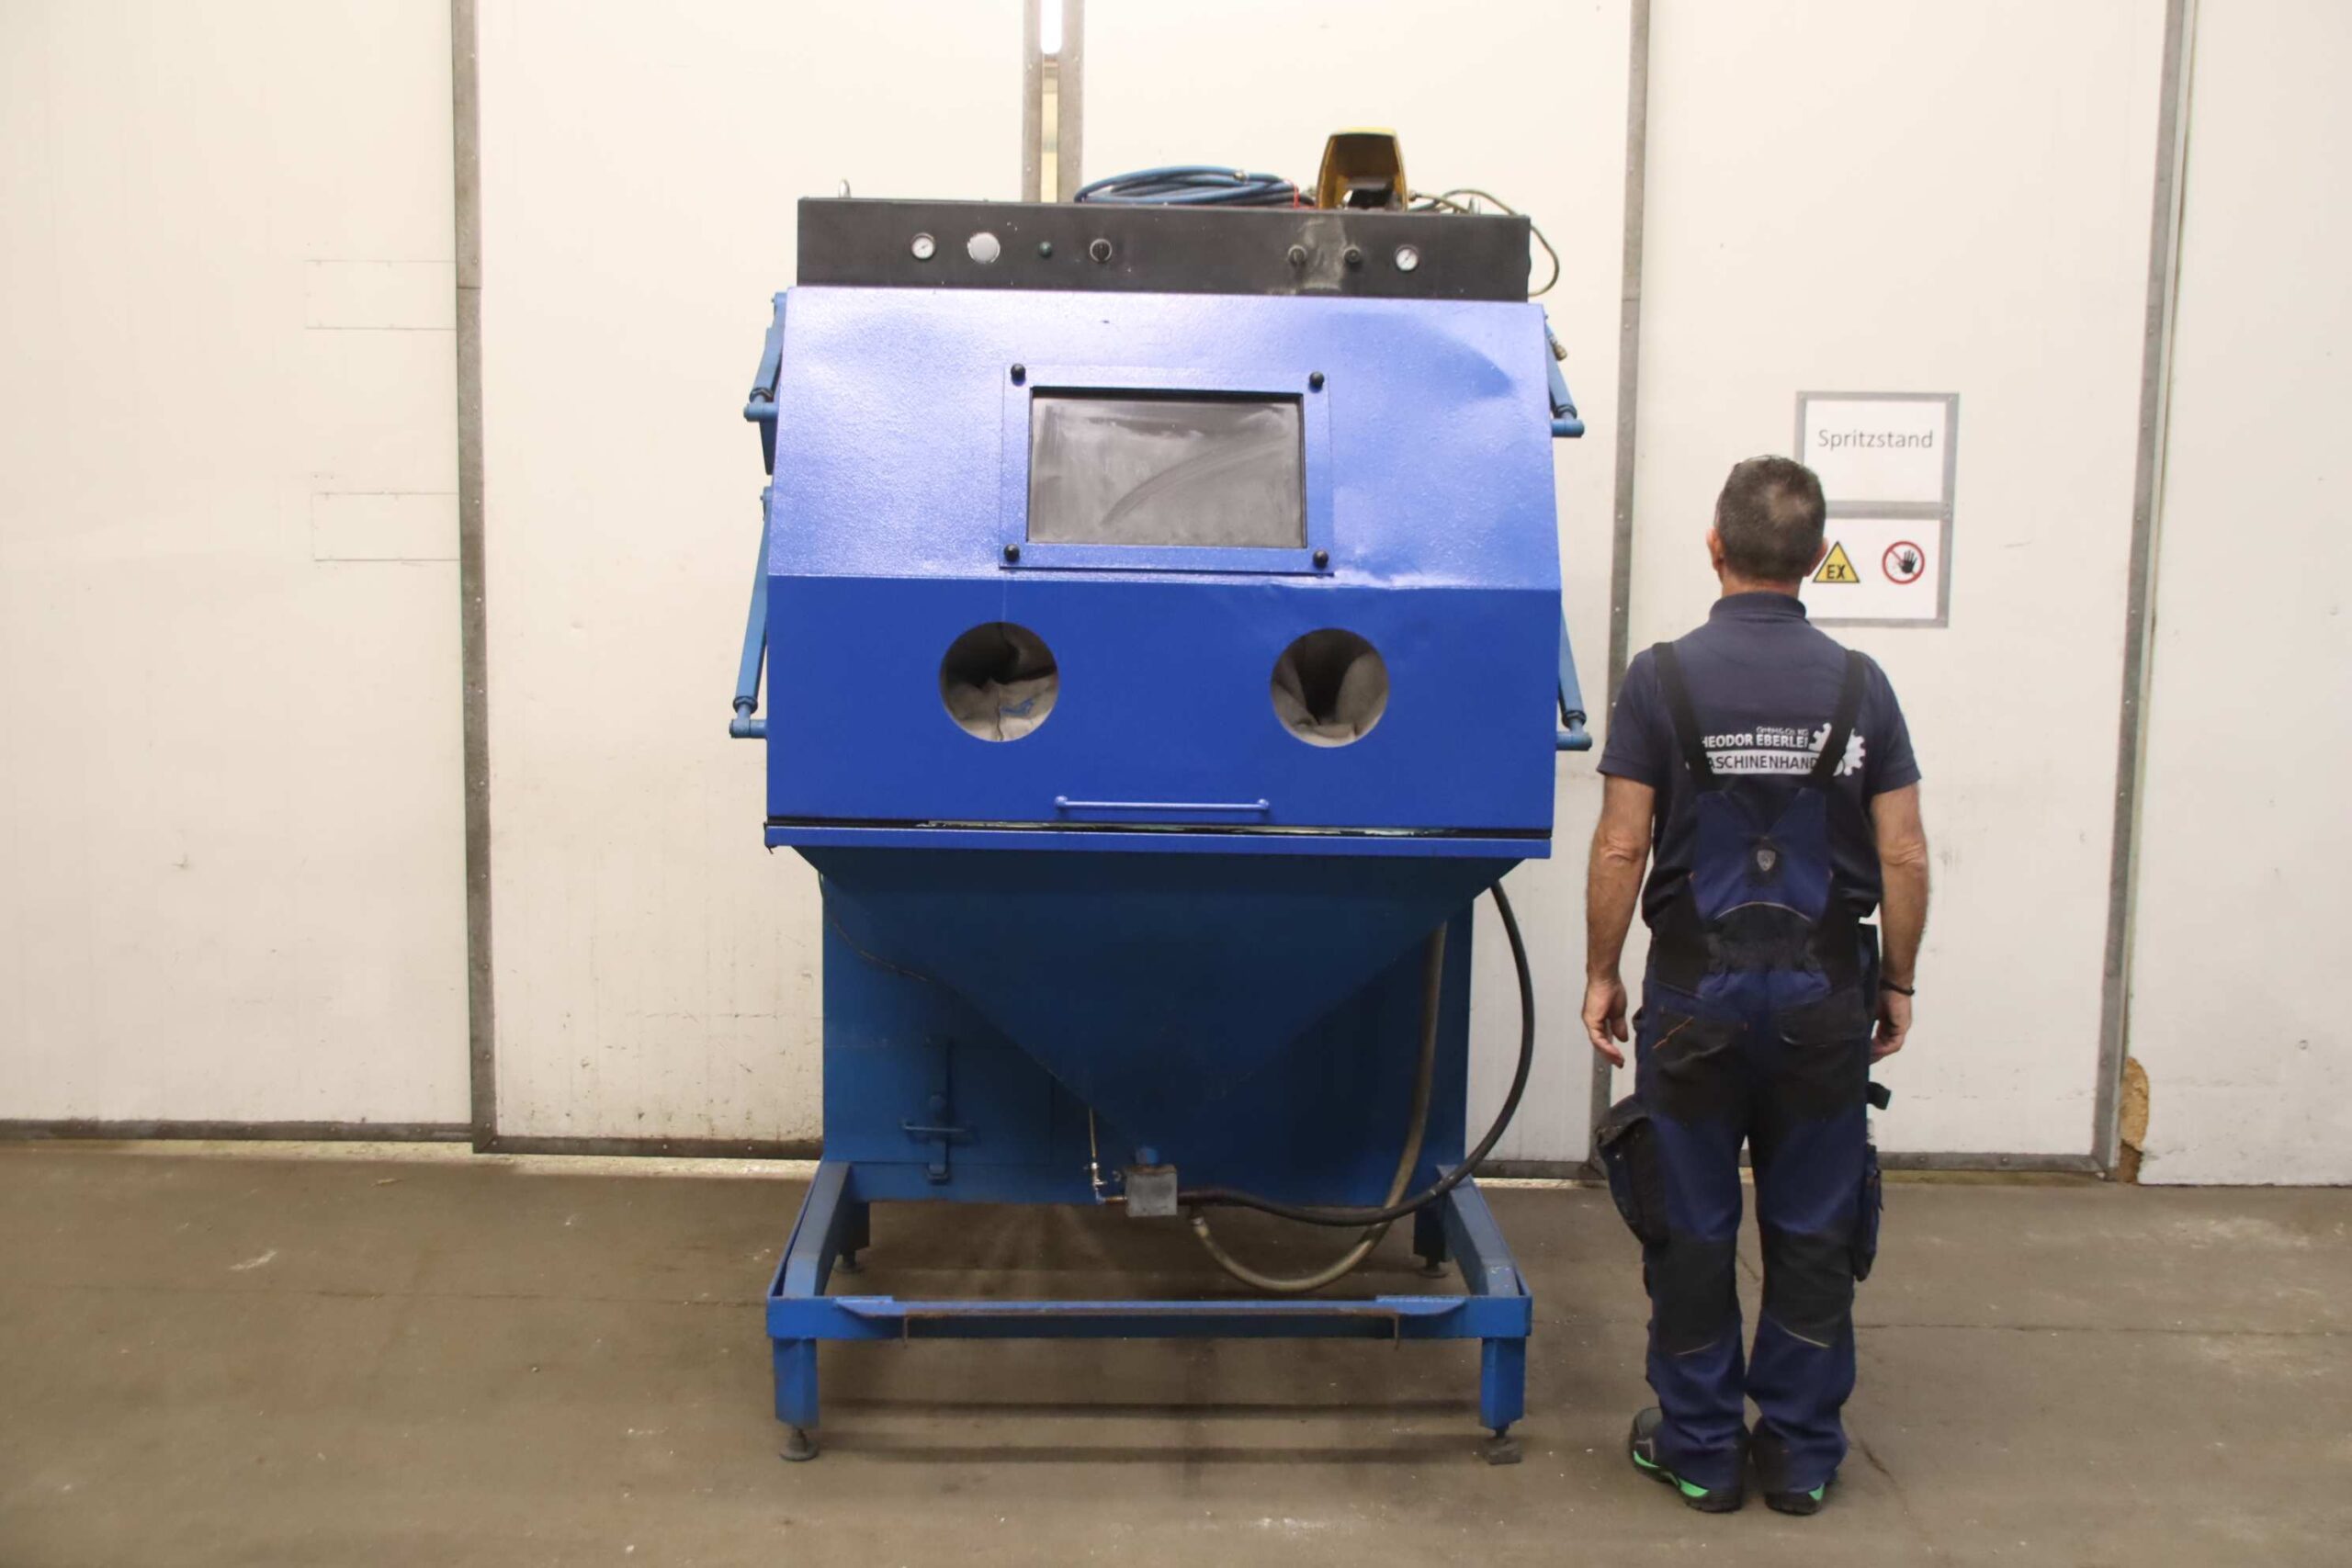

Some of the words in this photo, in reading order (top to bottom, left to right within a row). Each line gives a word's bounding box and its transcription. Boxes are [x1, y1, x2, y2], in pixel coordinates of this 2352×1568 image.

[1817, 429, 1934, 451] Spritzstand
[1827, 564, 1846, 579] EX
[1702, 733, 1754, 749] HEODOR
[1756, 734, 1809, 749] EBERLEI
